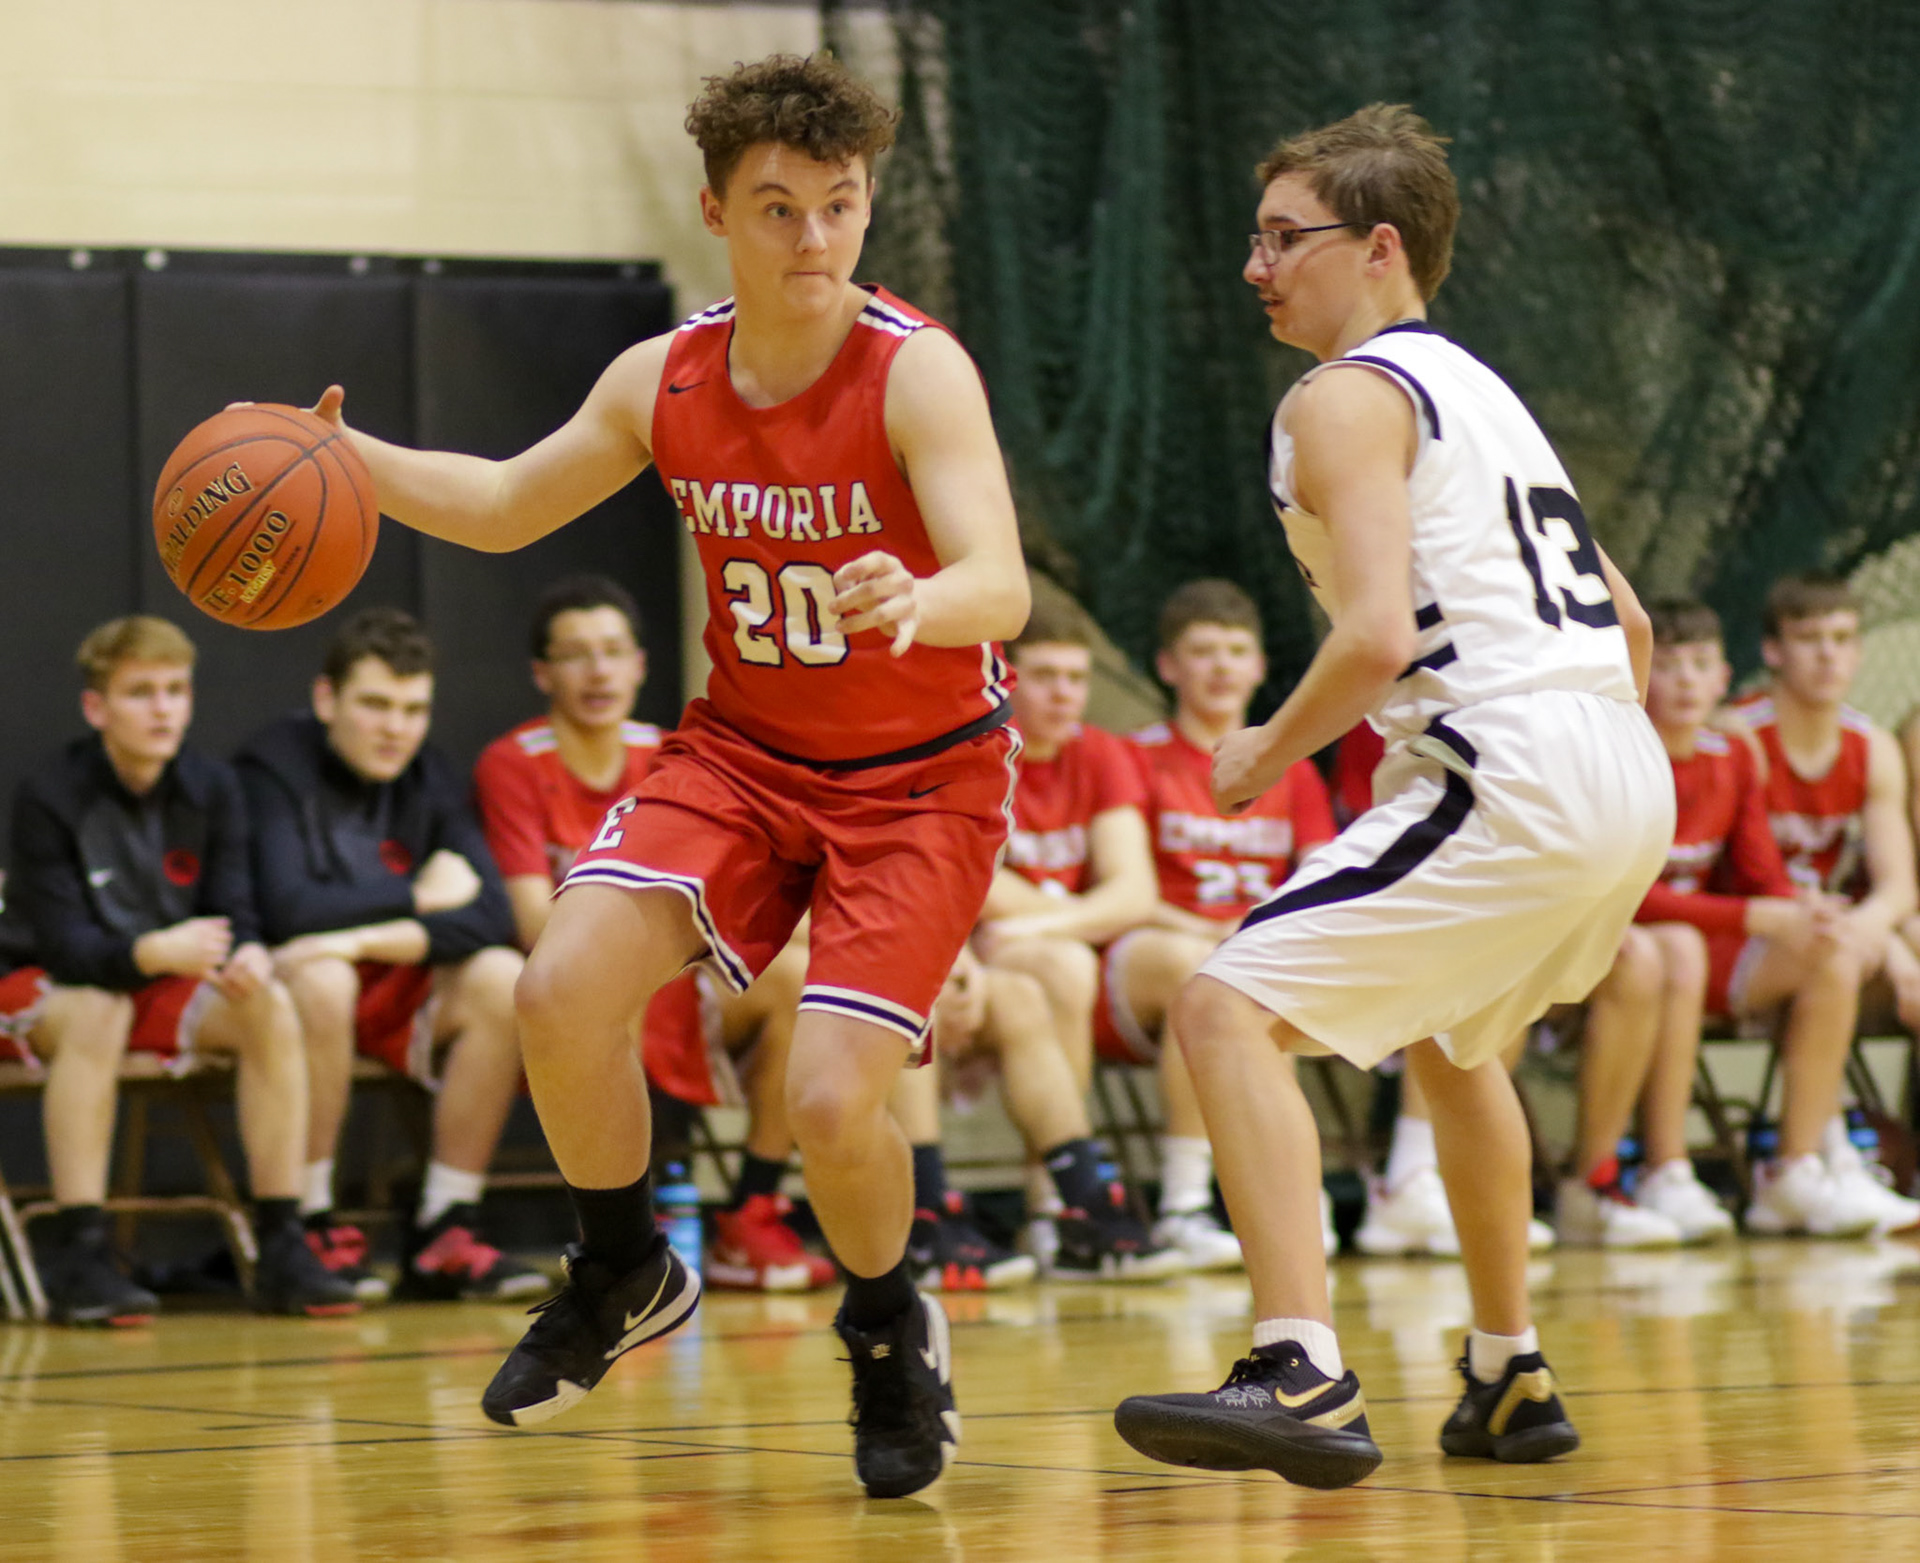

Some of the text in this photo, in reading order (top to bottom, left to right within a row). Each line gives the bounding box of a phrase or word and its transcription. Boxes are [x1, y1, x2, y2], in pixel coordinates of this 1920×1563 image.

[670, 477, 883, 541] EMPORIA
[1503, 472, 1624, 632] 13
[720, 556, 850, 669] 20
[588, 796, 638, 852] E
